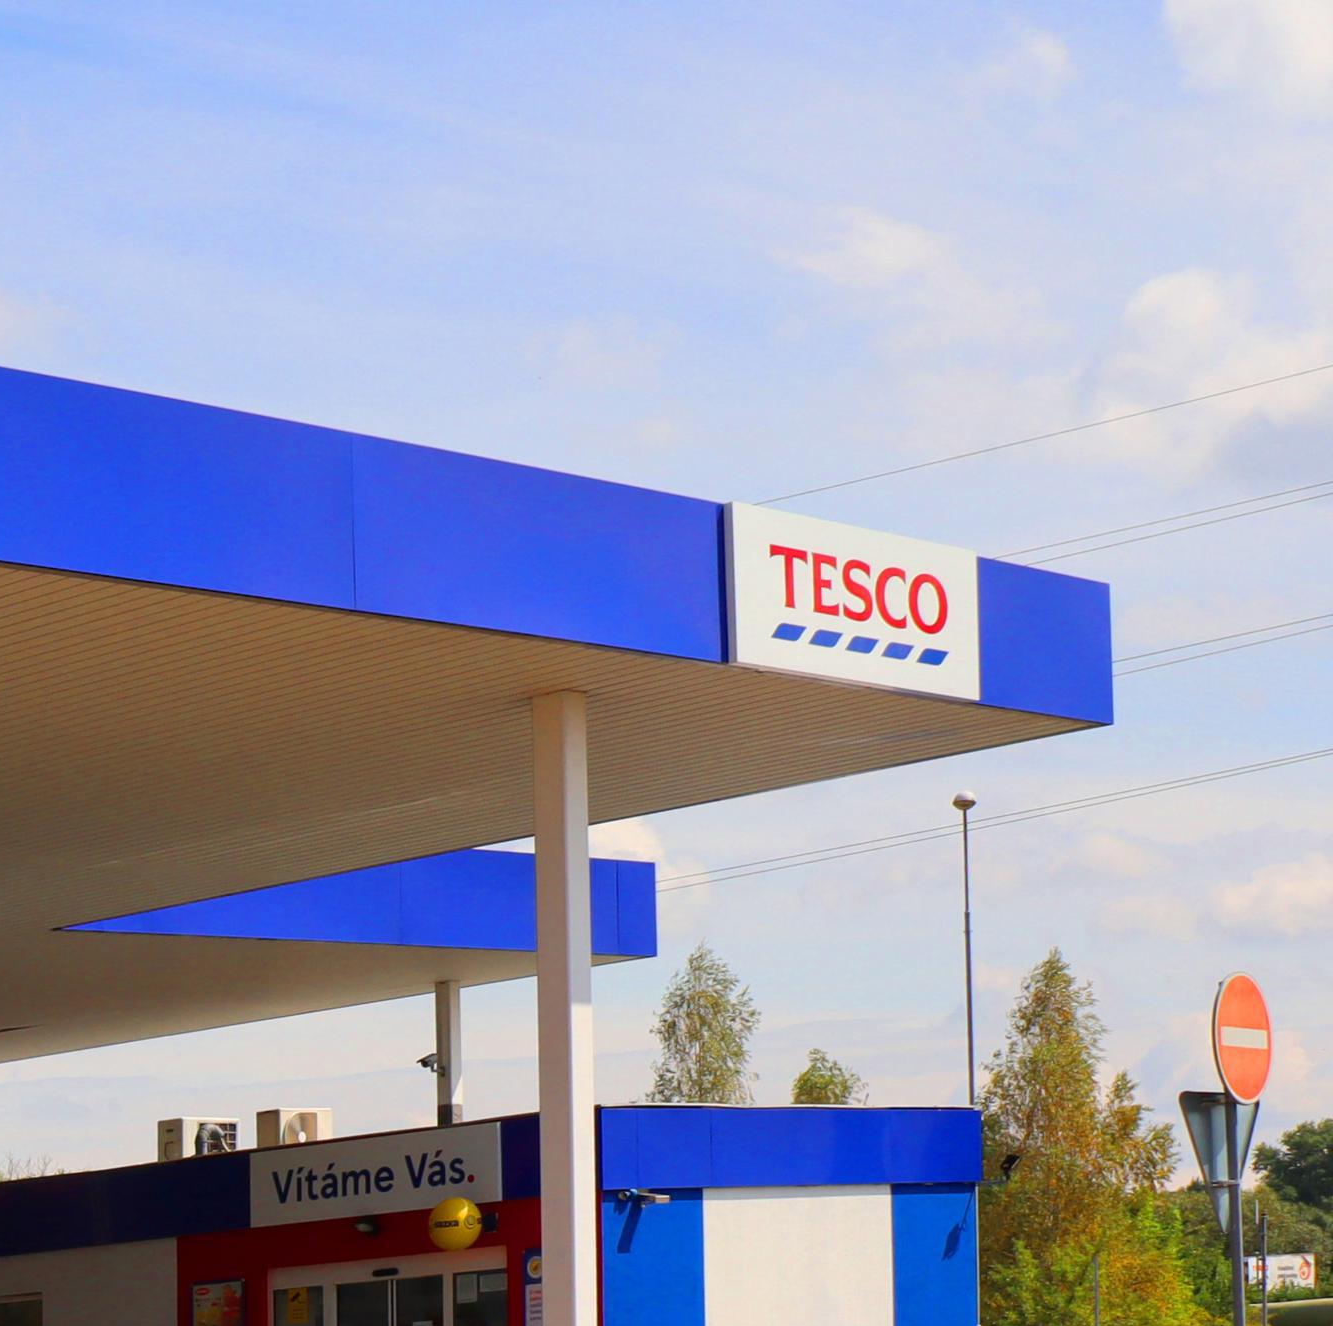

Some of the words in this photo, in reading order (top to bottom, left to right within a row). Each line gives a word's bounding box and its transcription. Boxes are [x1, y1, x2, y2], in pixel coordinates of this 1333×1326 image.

[769, 543, 948, 635] TESCO
[271, 1162, 394, 1204] Vítáme
[404, 1149, 475, 1189] Vás.
